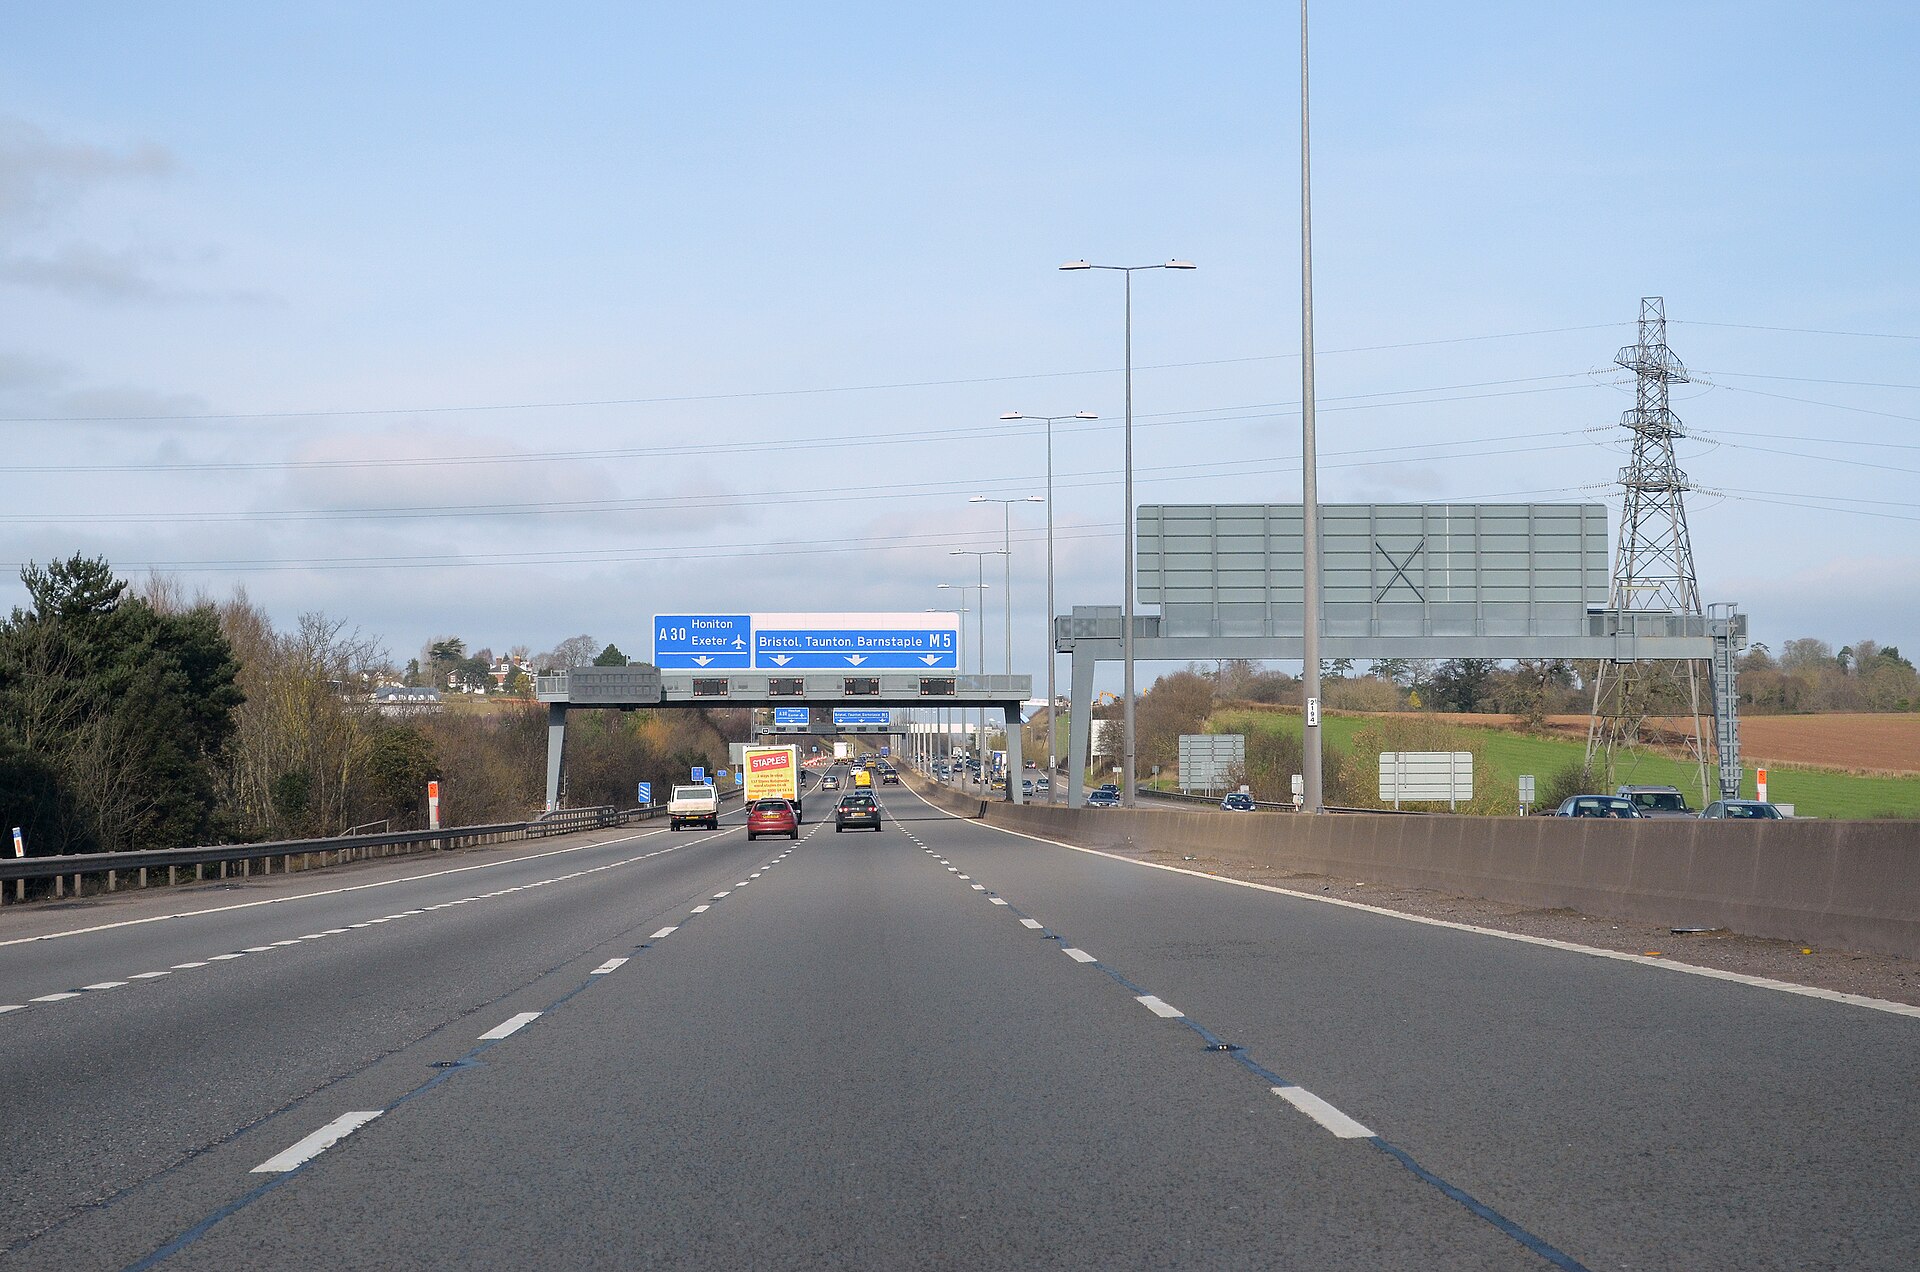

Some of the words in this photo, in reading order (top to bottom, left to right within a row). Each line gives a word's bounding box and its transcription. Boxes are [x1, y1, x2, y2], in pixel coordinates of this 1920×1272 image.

[691, 619, 733, 629] Honiton
[691, 636, 728, 646] Exeter
[759, 636, 802, 648] Bristol,
[805, 636, 854, 648] Taunton,
[857, 636, 923, 649] Barnstaple
[752, 755, 787, 768] STAPLES
